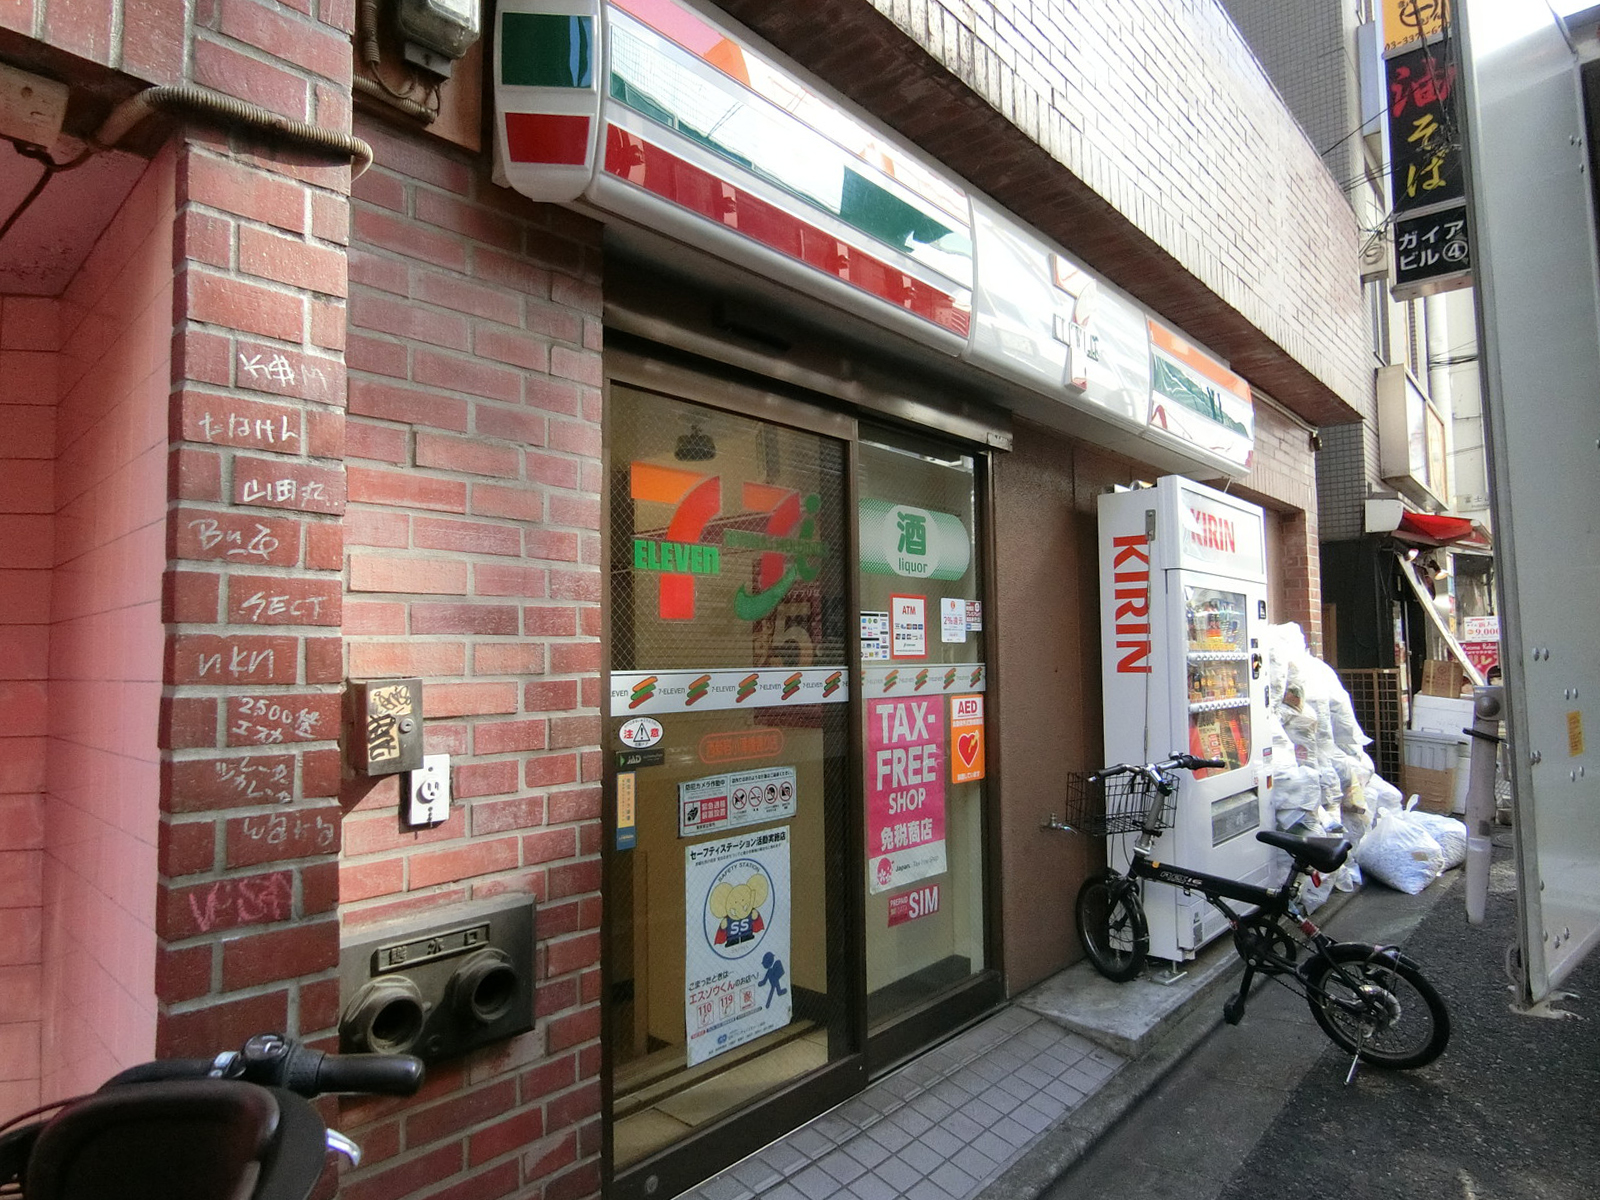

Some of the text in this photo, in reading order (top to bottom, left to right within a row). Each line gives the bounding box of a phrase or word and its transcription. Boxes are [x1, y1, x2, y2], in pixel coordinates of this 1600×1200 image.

[1399, 220, 1464, 251] ガイア
[897, 511, 927, 557] 酒
[898, 557, 928, 575] liquor
[902, 605, 916, 615] ATM
[1113, 534, 1152, 673] KIRIN
[957, 700, 978, 714] AED
[876, 701, 935, 744] TAX-
[876, 744, 937, 791] FREE
[888, 787, 926, 815] SHOP
[690, 831, 786, 861] セーフティステーション活動実施店
[738, 861, 761, 873] STATION
[908, 885, 938, 919] SIM
[698, 994, 734, 1016] 110 119
